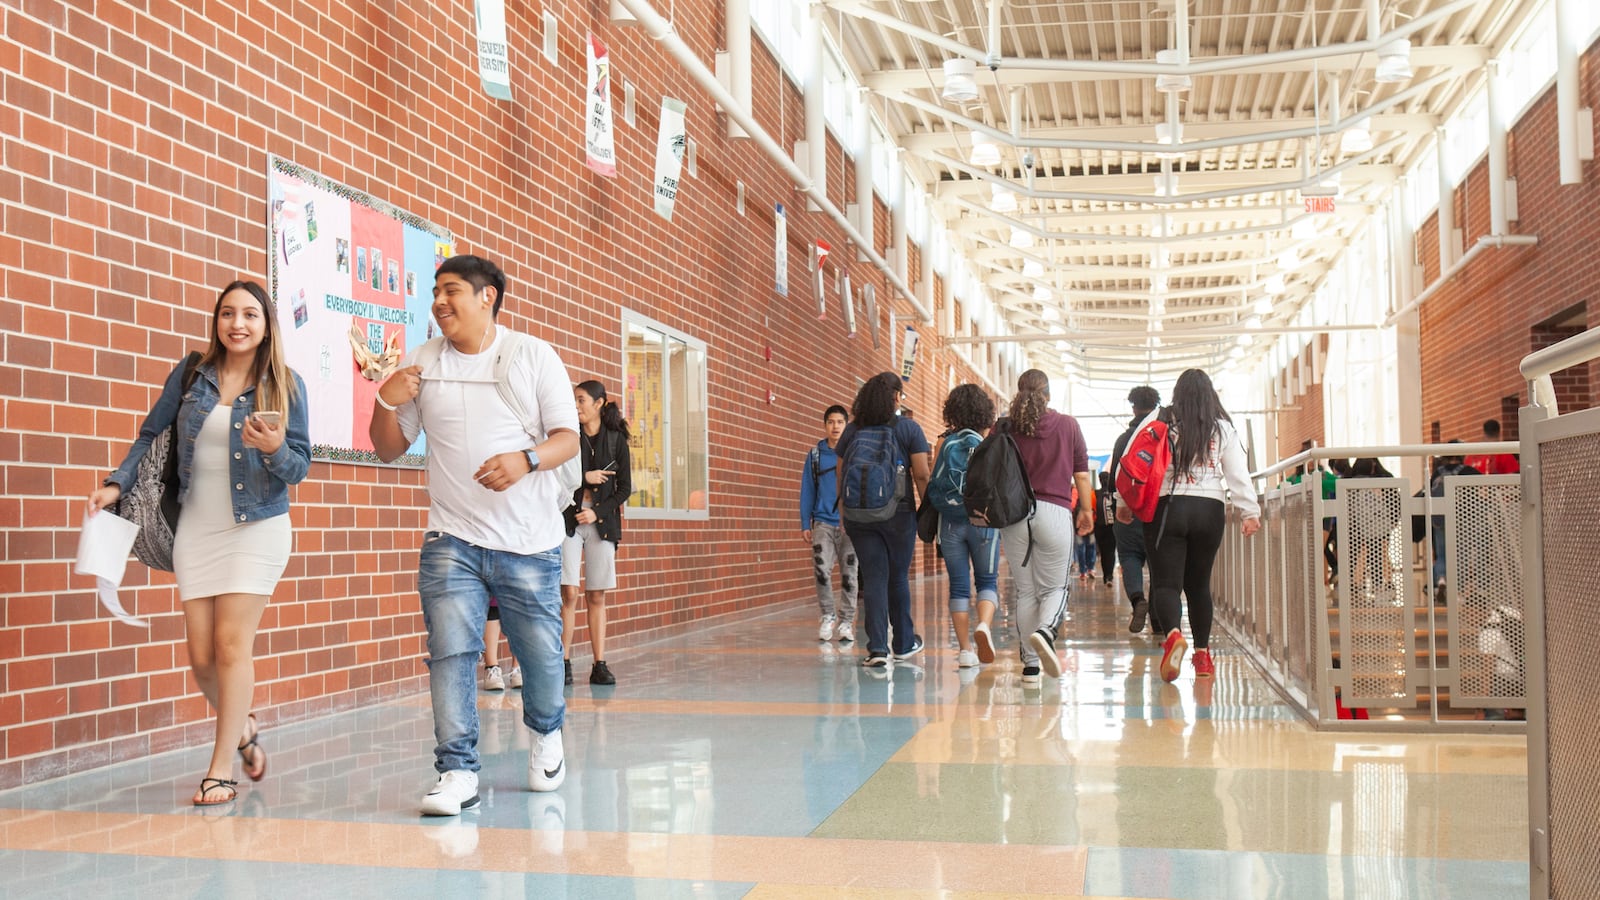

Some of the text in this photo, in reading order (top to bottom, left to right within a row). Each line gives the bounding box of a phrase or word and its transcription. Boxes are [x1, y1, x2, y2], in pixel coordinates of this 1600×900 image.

[1304, 197, 1335, 213] STAIRS
[326, 294, 367, 317] EVERYBODY
[378, 306, 407, 324] WELCOME
[369, 323, 381, 338] THE
